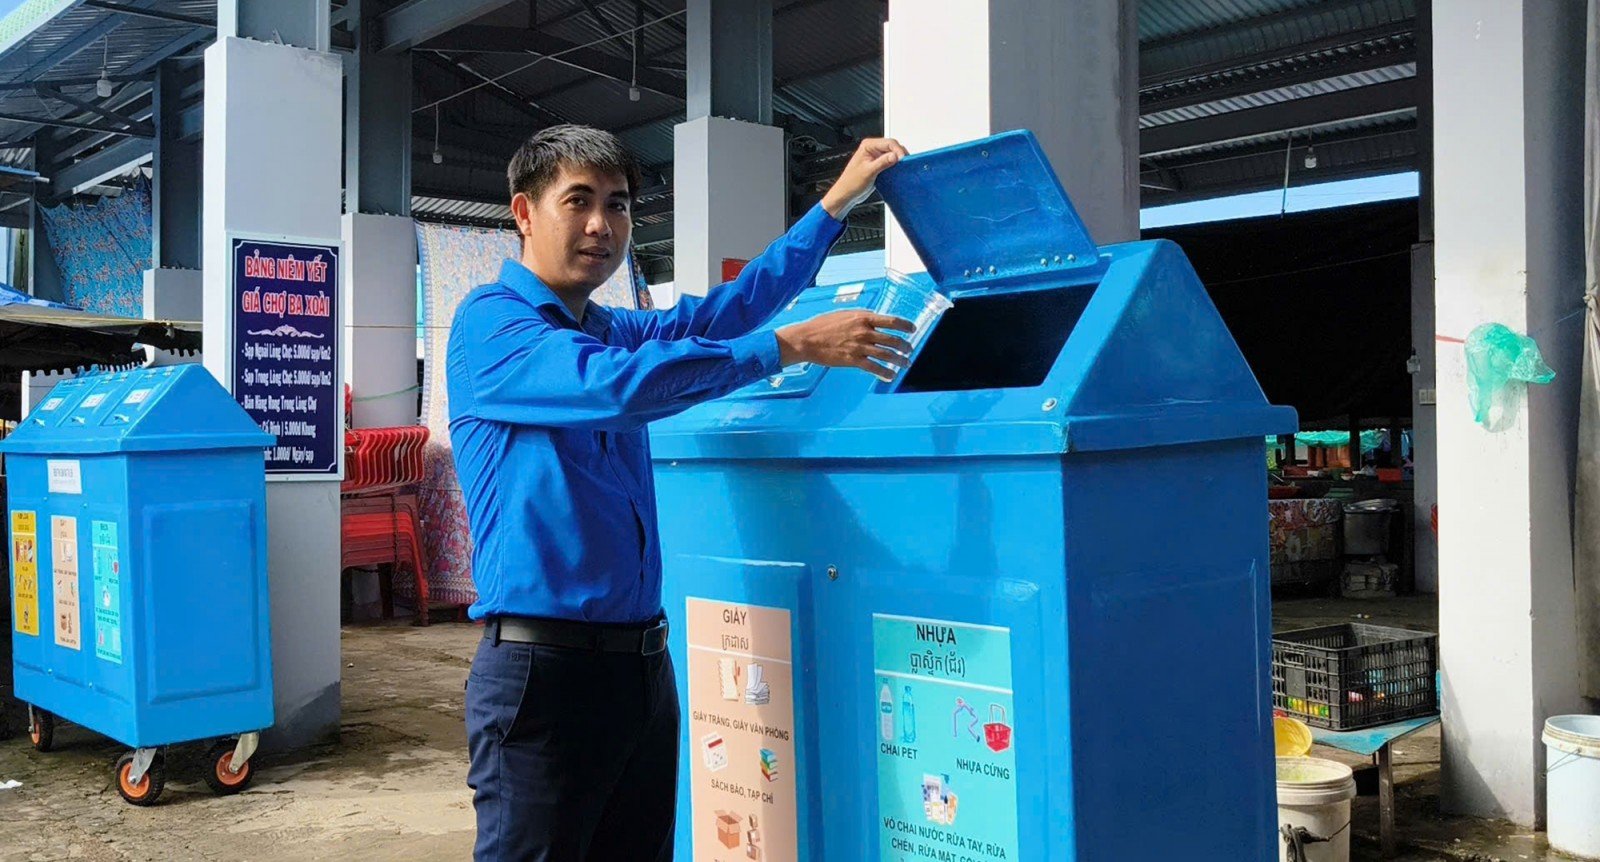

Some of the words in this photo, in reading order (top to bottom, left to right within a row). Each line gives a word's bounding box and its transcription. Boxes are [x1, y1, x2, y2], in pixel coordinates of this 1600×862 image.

[245, 249, 275, 279] BẢNG
[277, 254, 305, 281] NIÊM
[306, 254, 328, 282] YẾT
[242, 286, 261, 313] GIÁ
[263, 291, 287, 318] CHỢ
[288, 294, 303, 315] BA
[305, 291, 330, 317] XOÀI
[723, 606, 747, 626] GIẤY
[916, 623, 957, 648] NHỰA
[765, 726, 789, 741] PHÒNG
[881, 742, 900, 757] CHAI
[902, 747, 918, 760] PET
[957, 757, 982, 775] NHỰA
[983, 762, 1010, 780] CỨNG
[747, 788, 760, 802] TẠP
[883, 815, 896, 830] VỎ
[897, 820, 917, 835] CHAI
[918, 825, 945, 842] NƯỚC
[946, 831, 966, 849] RỬA
[967, 837, 985, 855] TAY,
[986, 843, 1007, 860] RỬA
[891, 837, 917, 855] CHÉN,
[918, 843, 938, 860] RỬA
